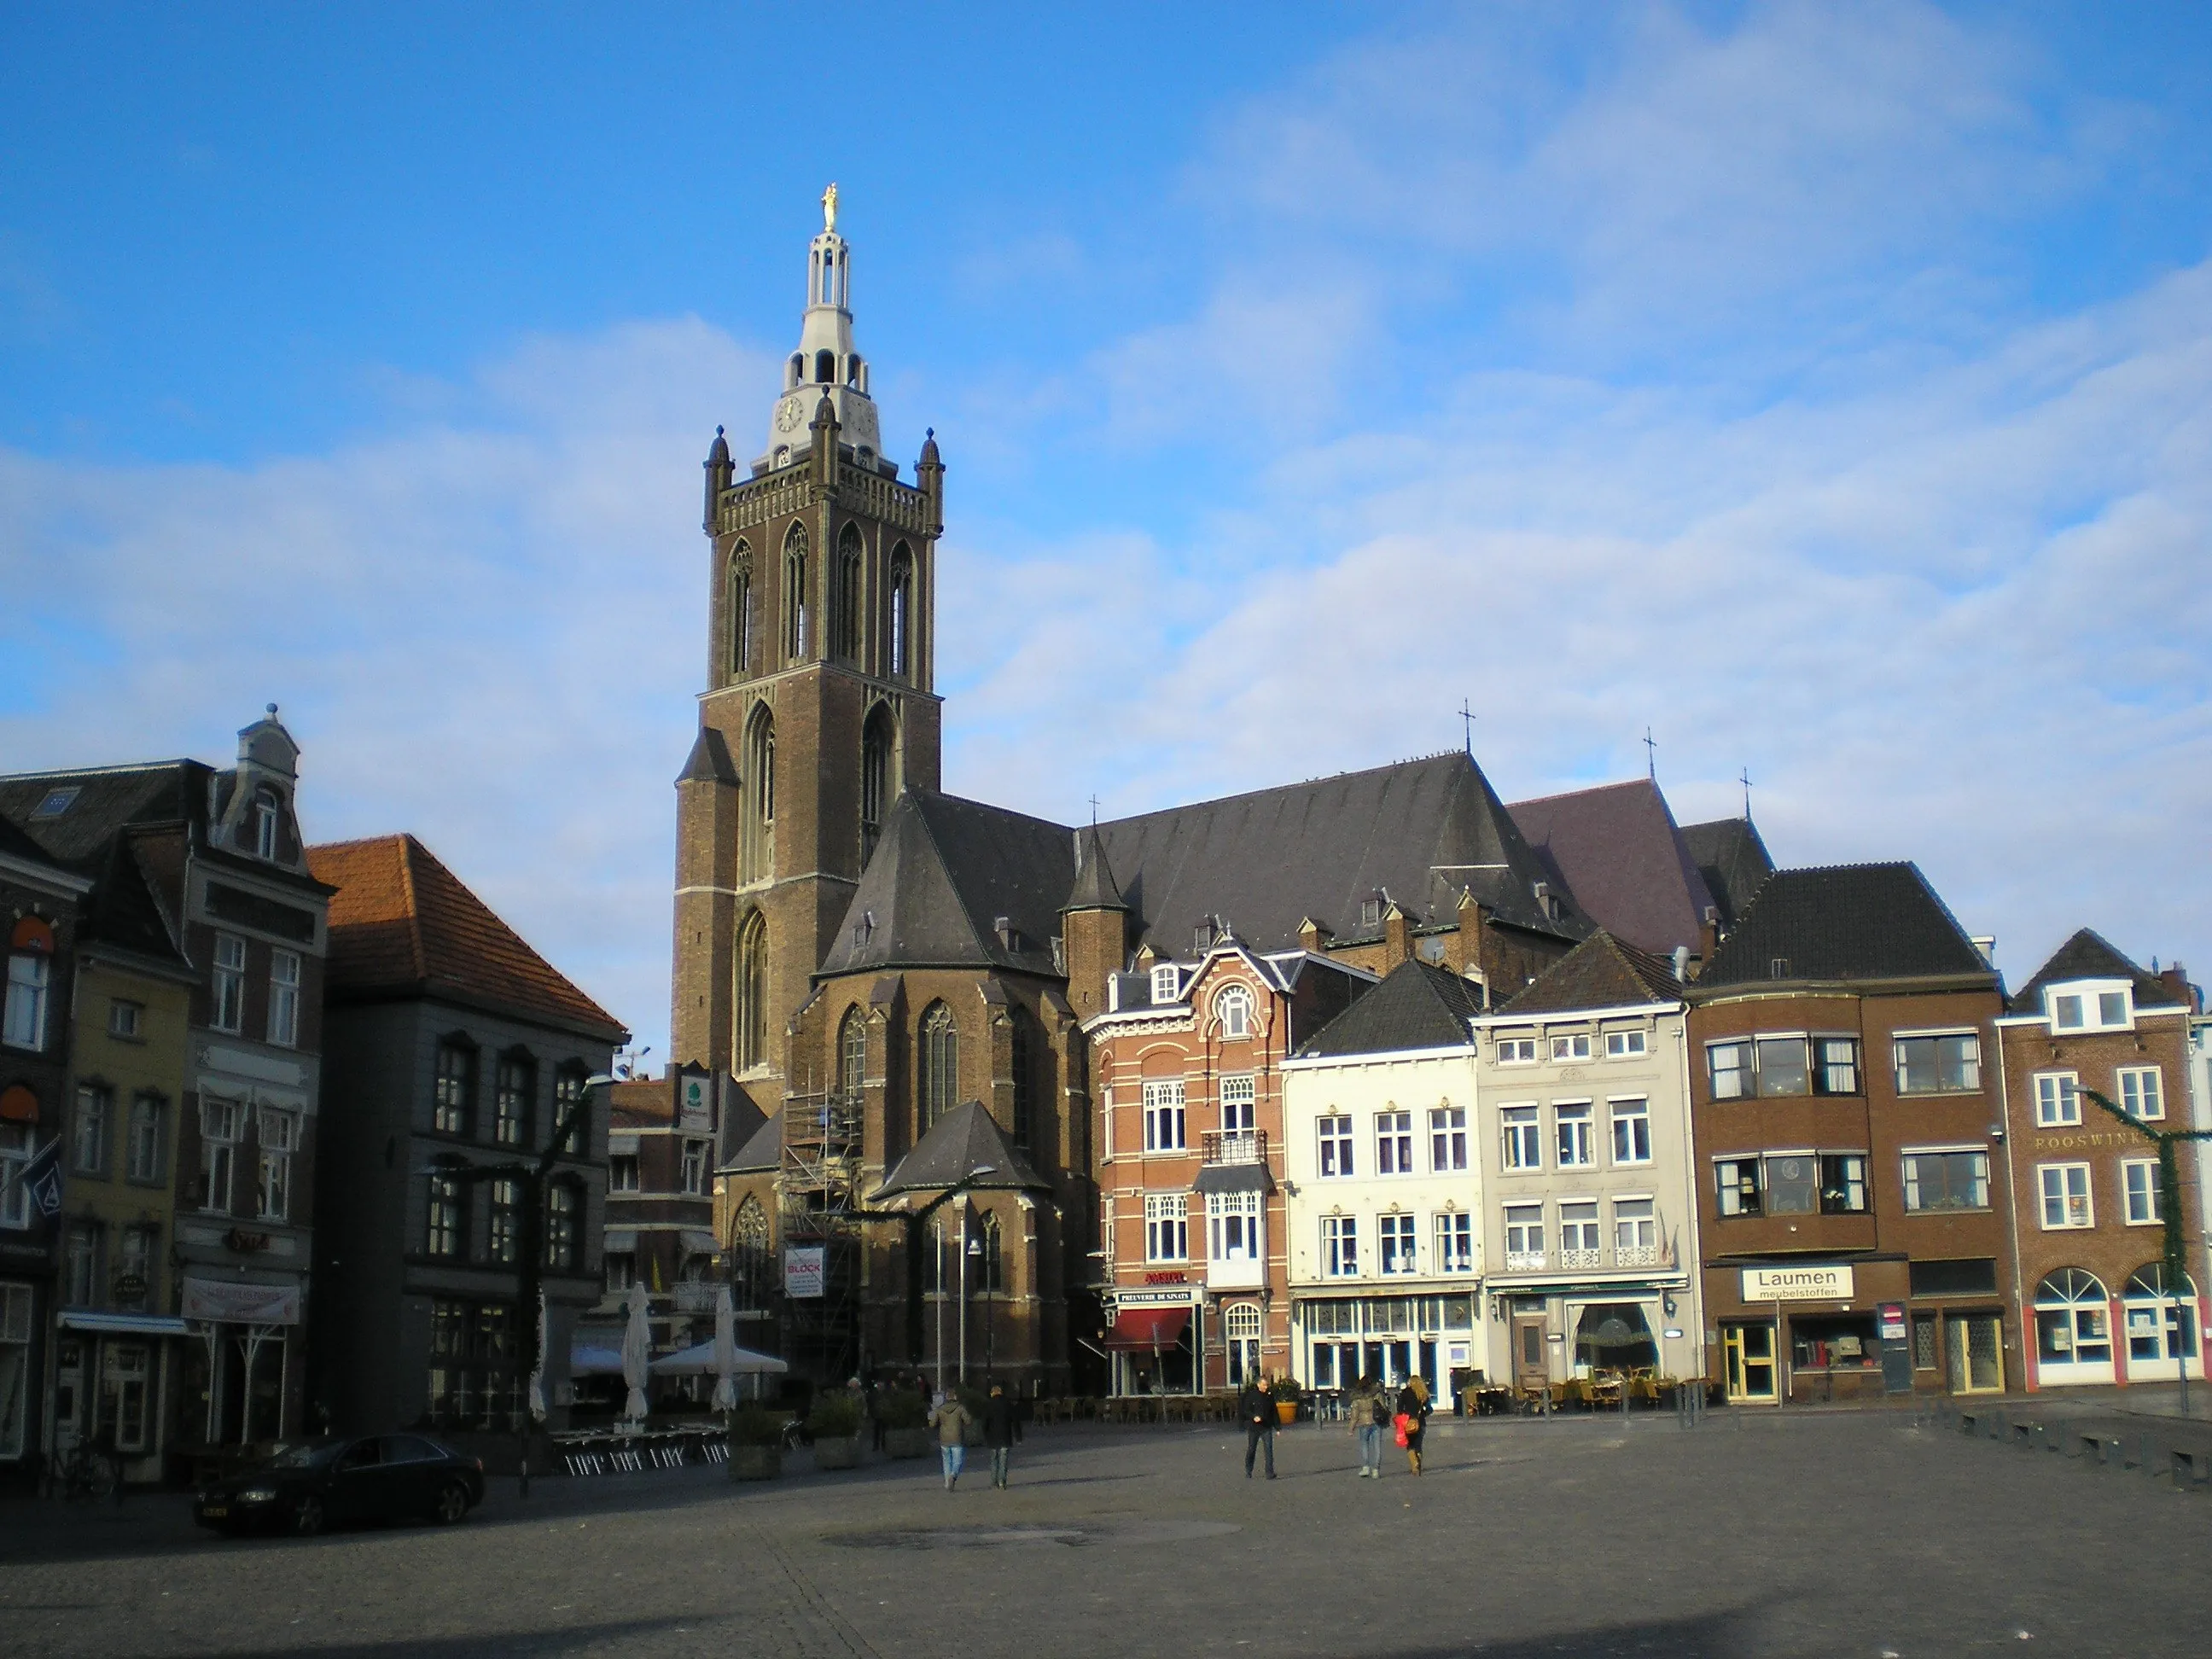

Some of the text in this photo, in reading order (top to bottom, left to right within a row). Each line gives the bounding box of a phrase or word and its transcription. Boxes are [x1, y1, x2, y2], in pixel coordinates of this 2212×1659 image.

[788, 1264, 820, 1273] BLOCK
[1758, 1272, 1837, 1286] Laumen
[1760, 1288, 1837, 1299] meubelstoffen
